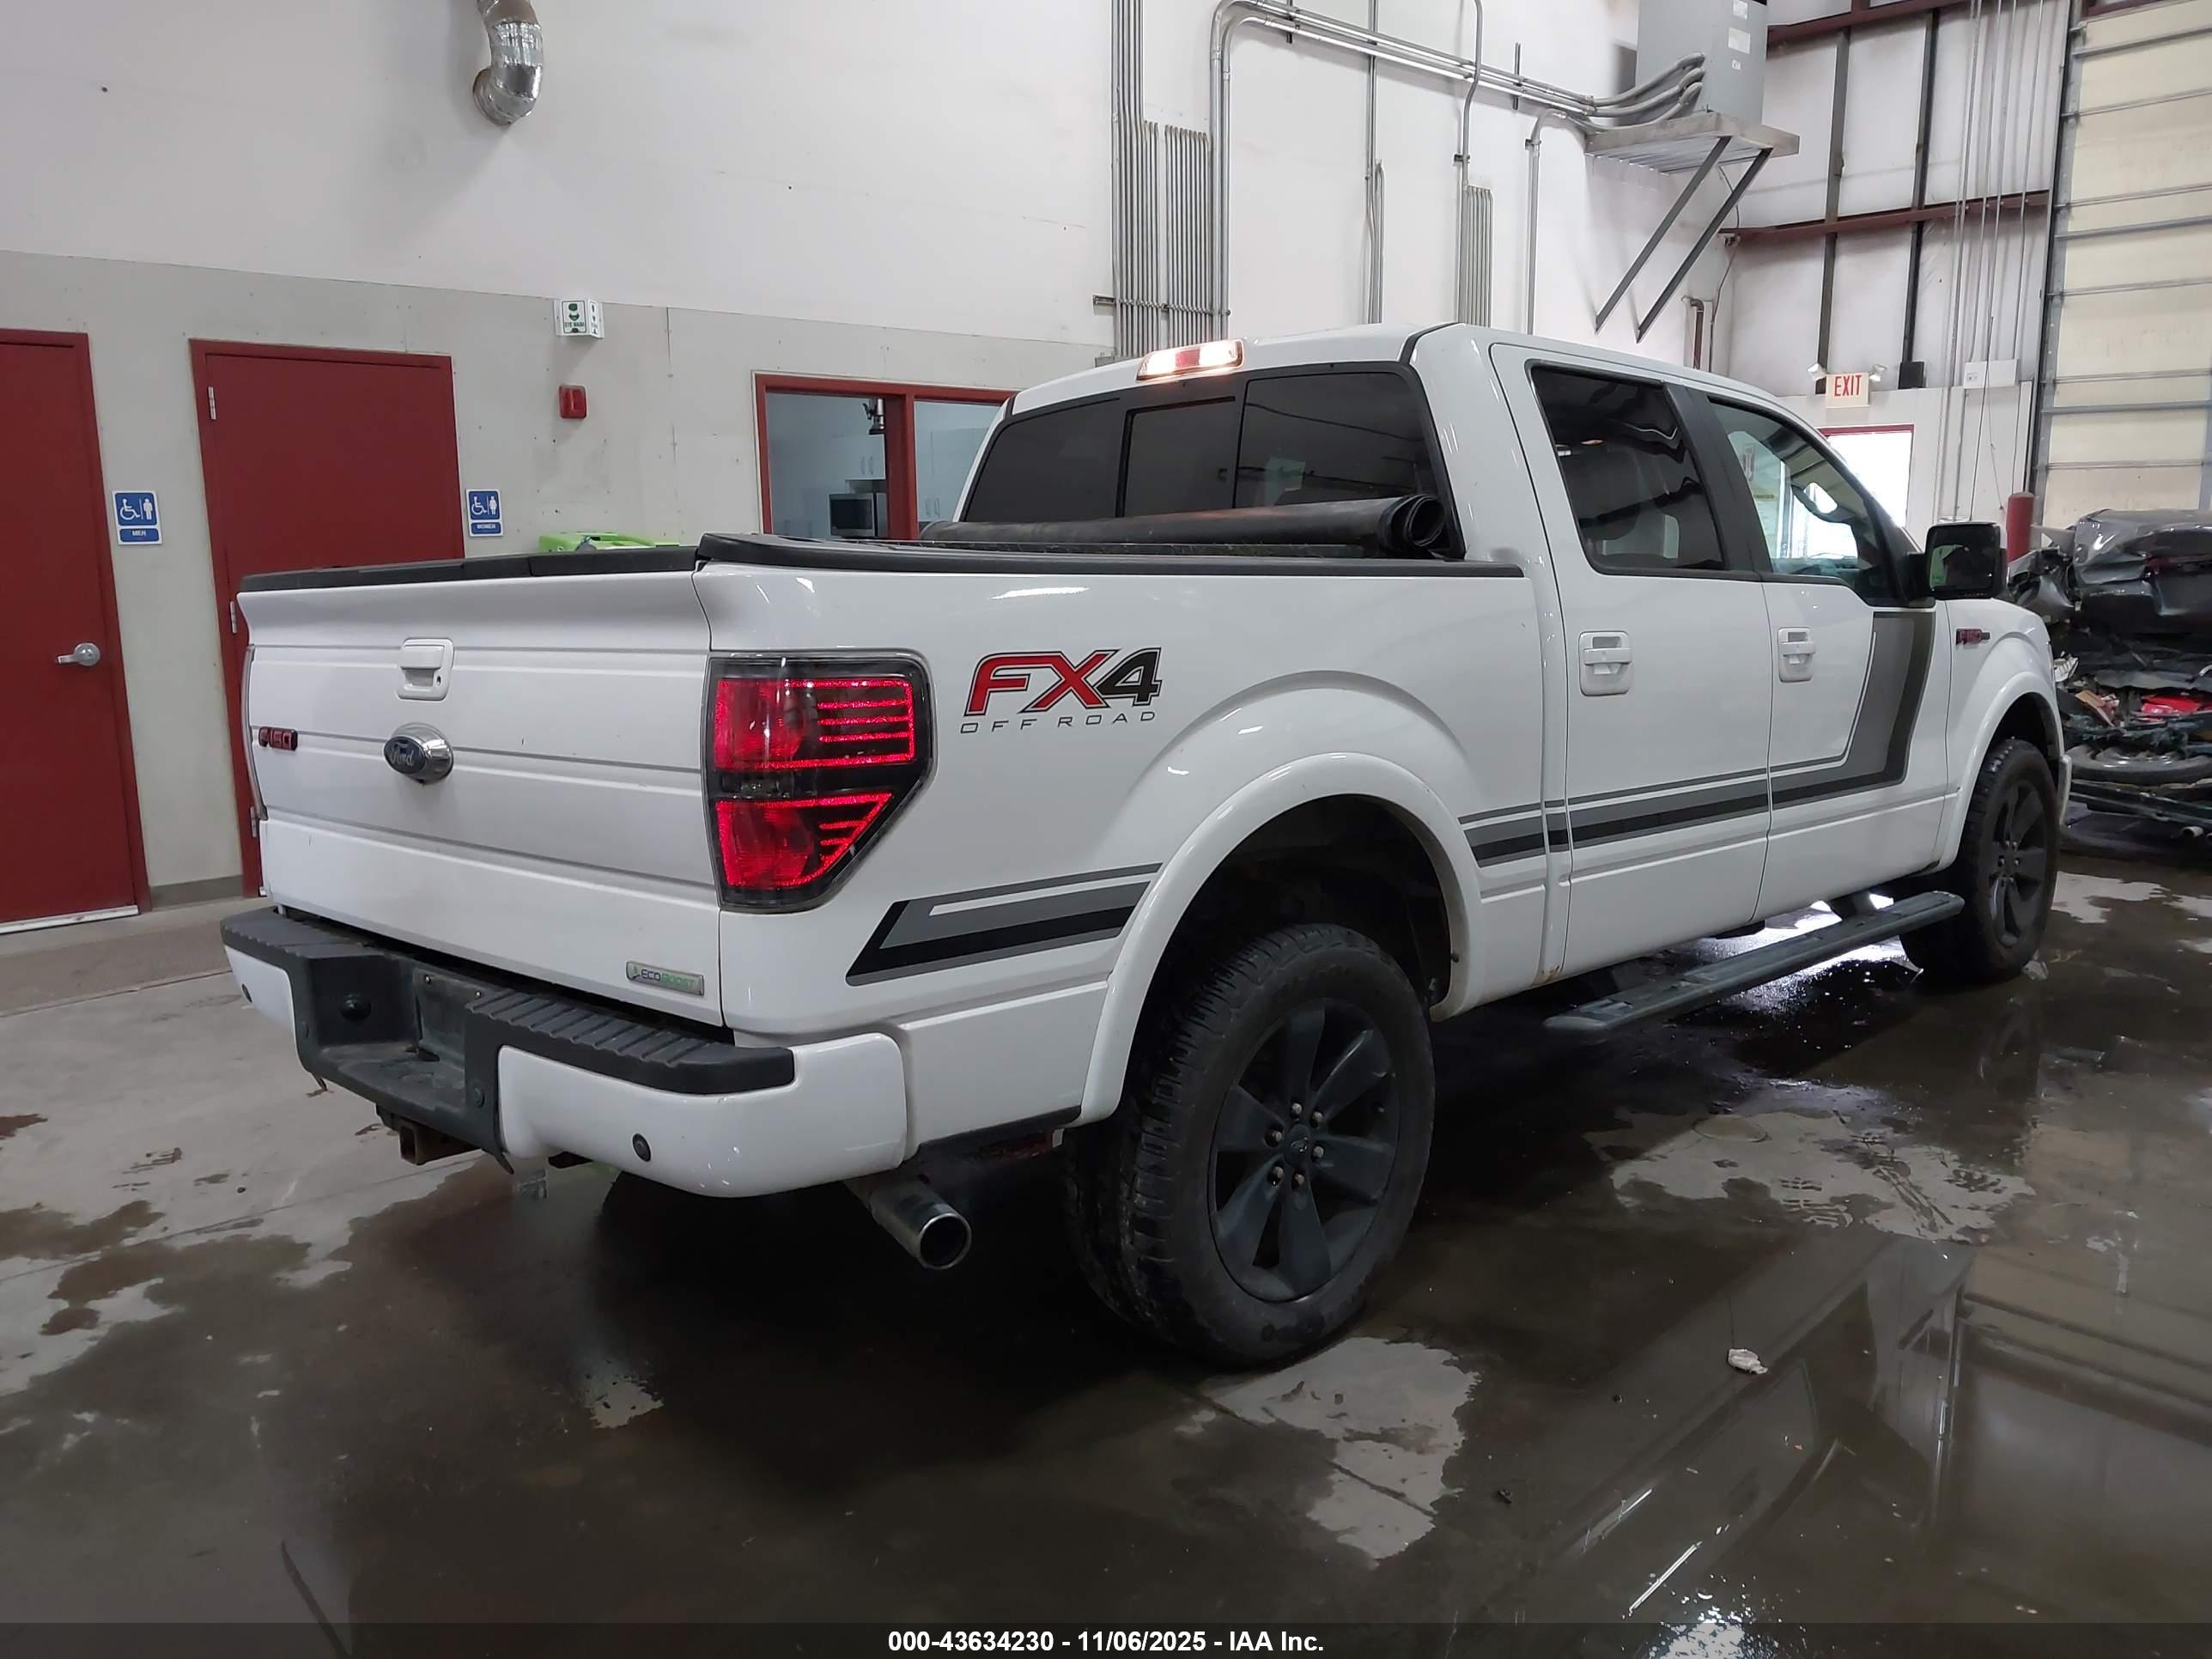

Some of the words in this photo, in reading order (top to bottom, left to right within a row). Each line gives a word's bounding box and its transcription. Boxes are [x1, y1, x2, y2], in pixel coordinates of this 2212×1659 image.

[1834, 374, 1862, 397] EXIT
[963, 647, 1163, 716] FX4
[960, 718, 1038, 734] OFF
[1057, 710, 1156, 728] ROAD
[390, 741, 416, 767] Ford
